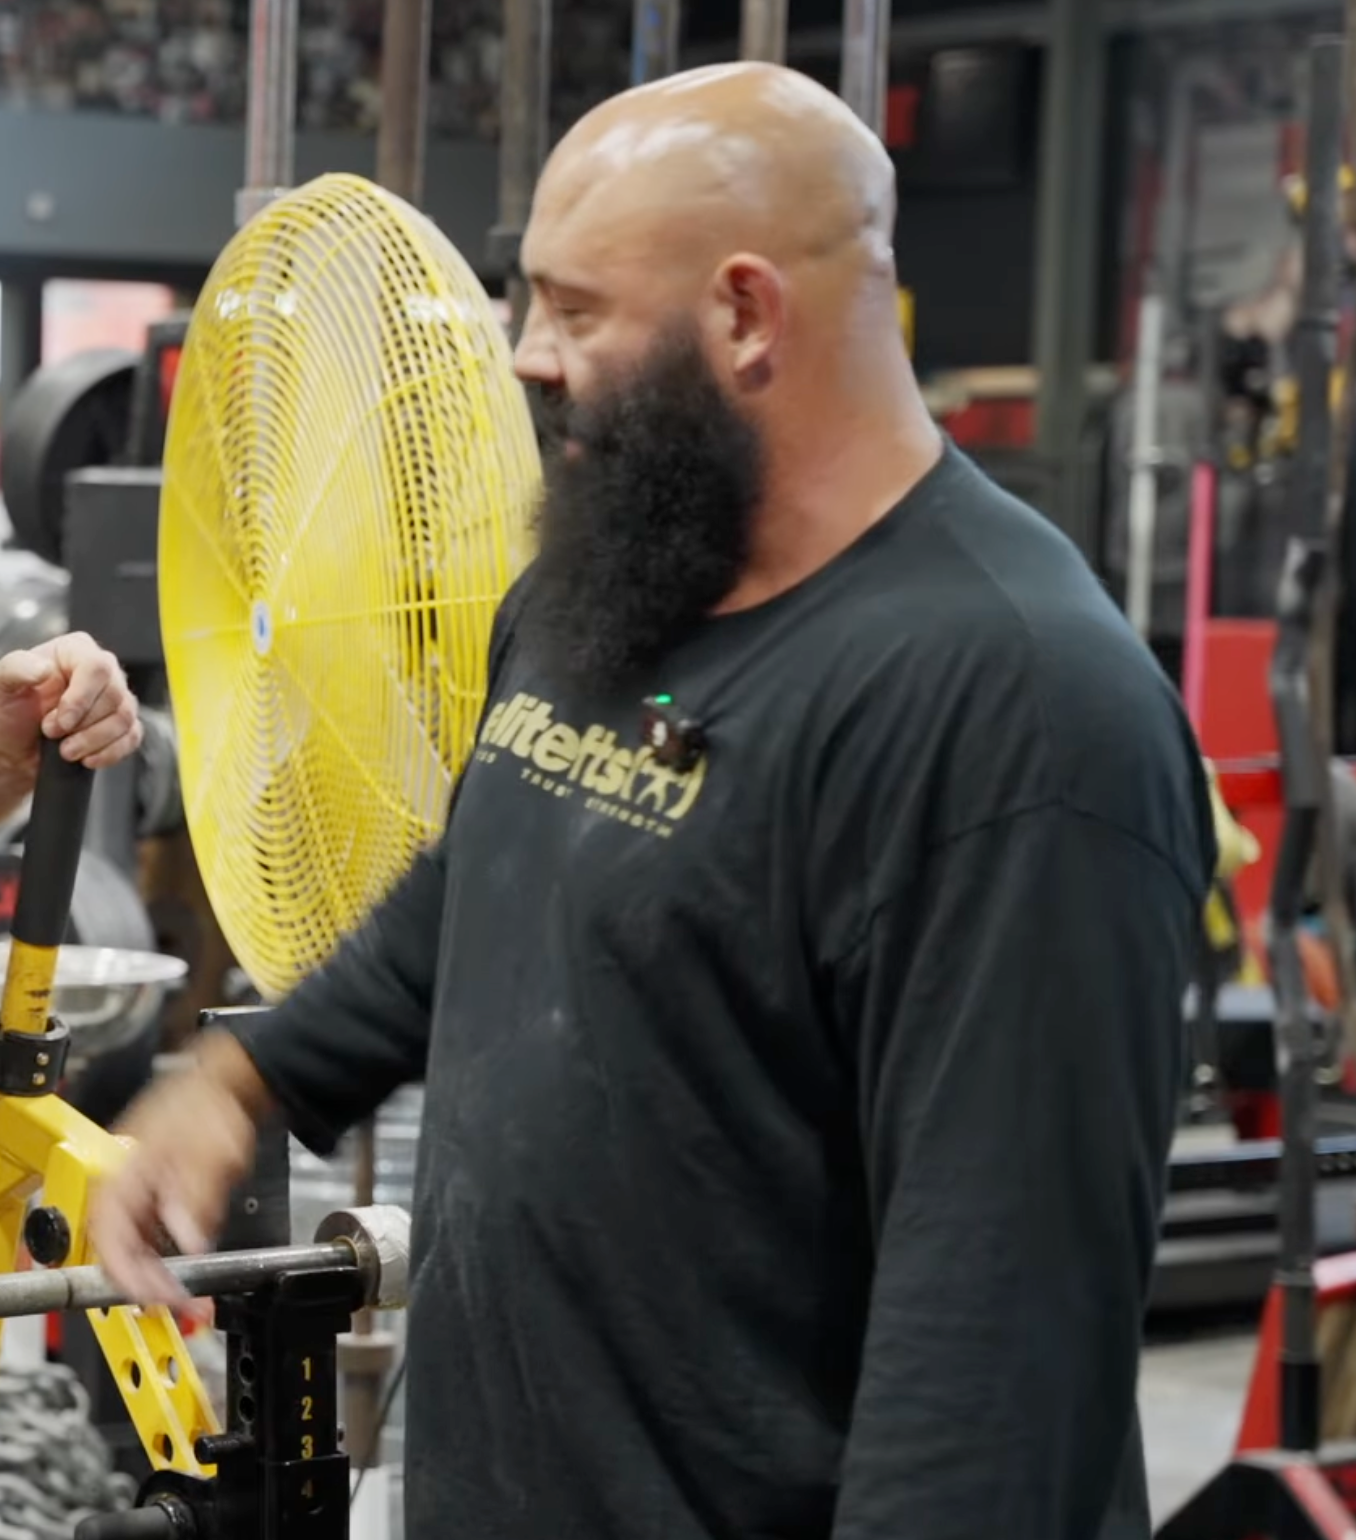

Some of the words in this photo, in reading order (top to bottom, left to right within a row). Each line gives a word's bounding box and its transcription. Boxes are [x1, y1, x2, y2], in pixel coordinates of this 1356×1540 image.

[301, 1356, 312, 1382] 1
[300, 1395, 313, 1421] 2
[300, 1434, 314, 1461] 3
